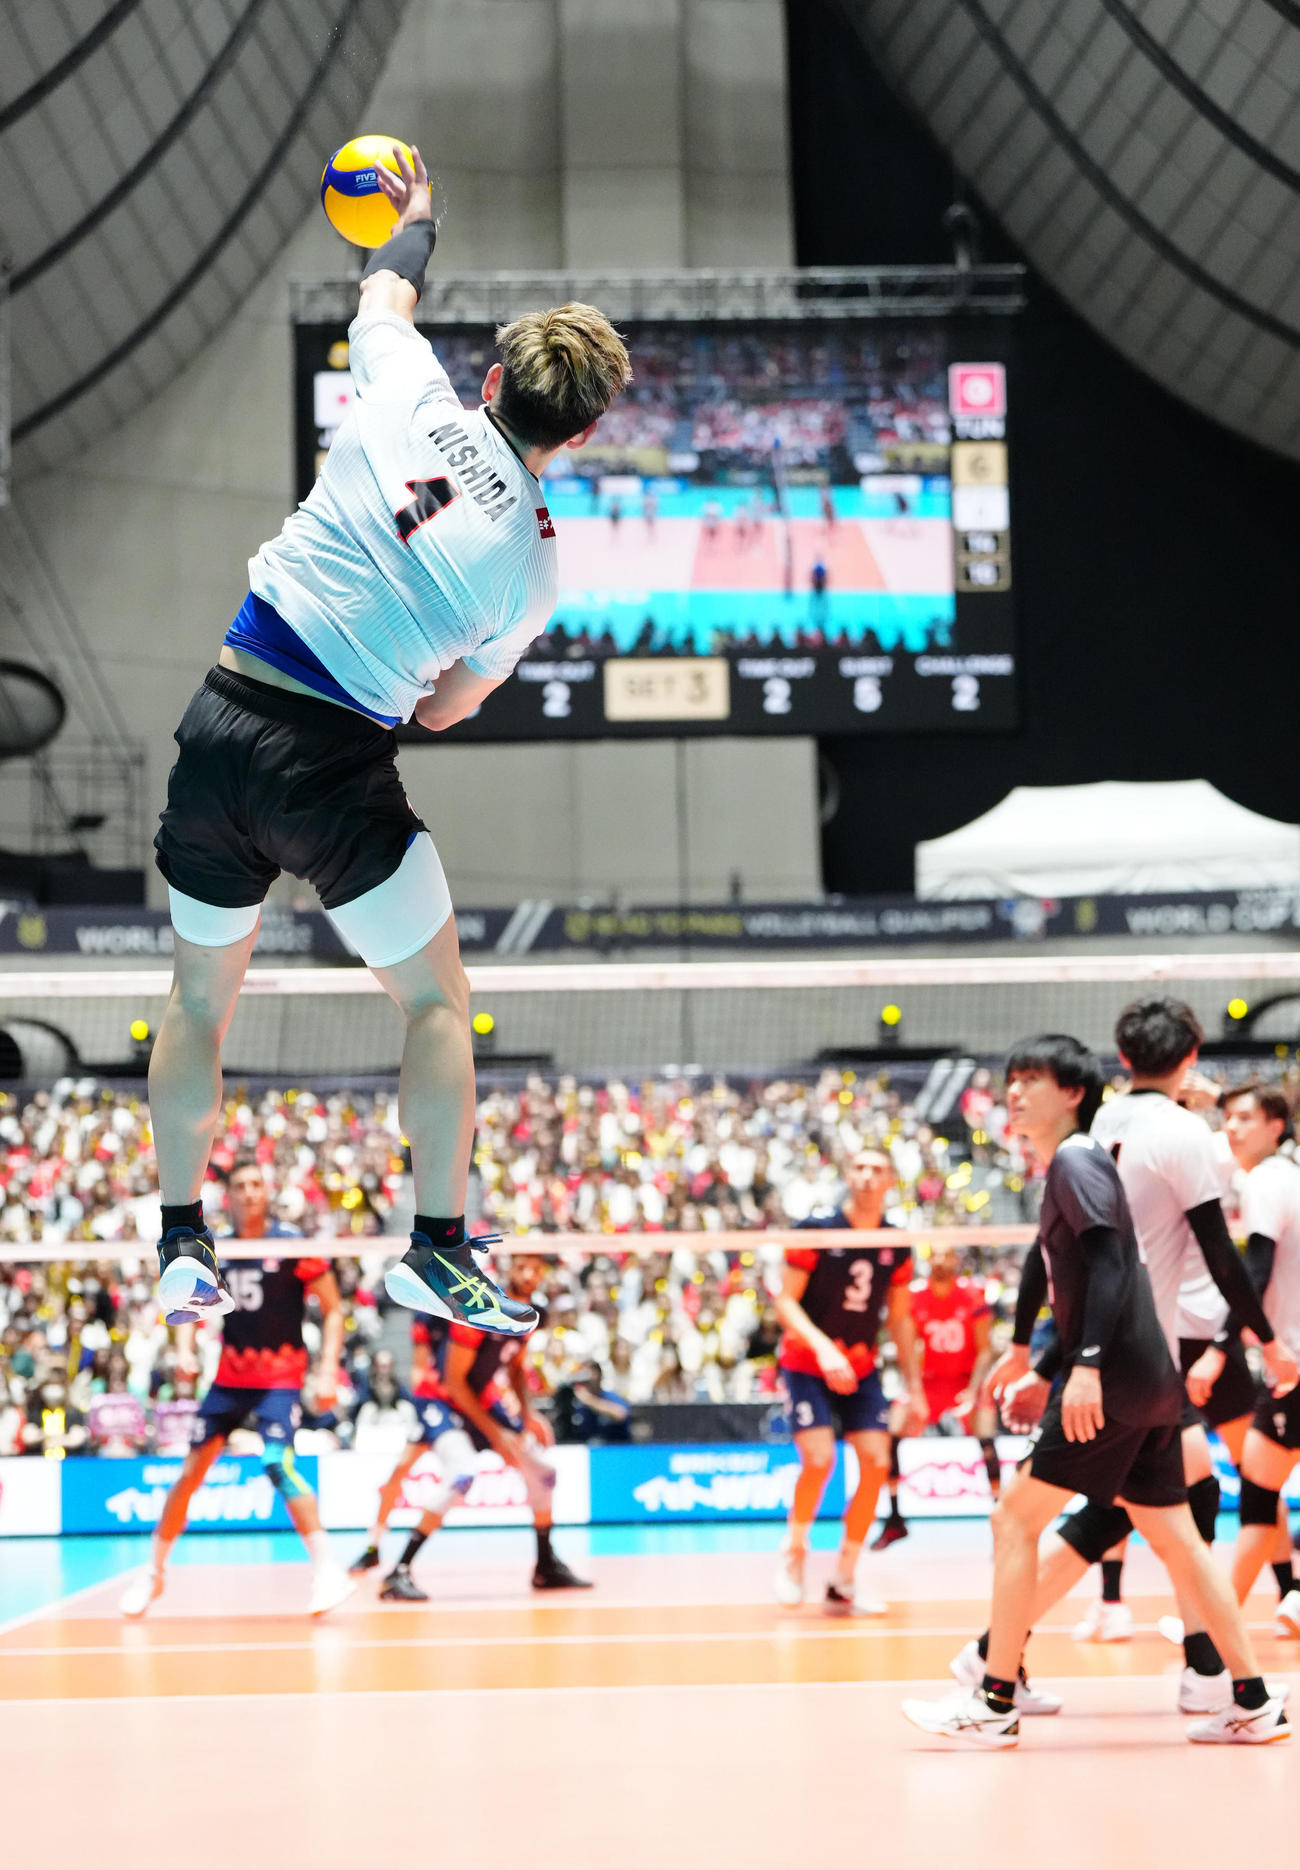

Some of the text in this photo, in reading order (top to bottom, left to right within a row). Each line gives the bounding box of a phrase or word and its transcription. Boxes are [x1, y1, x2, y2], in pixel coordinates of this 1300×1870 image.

[427, 421, 518, 522] NISHIDA
[395, 475, 463, 548] 1
[542, 680, 572, 718] 2
[686, 669, 709, 705] 3
[762, 676, 792, 715] 2
[951, 674, 981, 712] 2
[844, 1259, 875, 1303] 3
